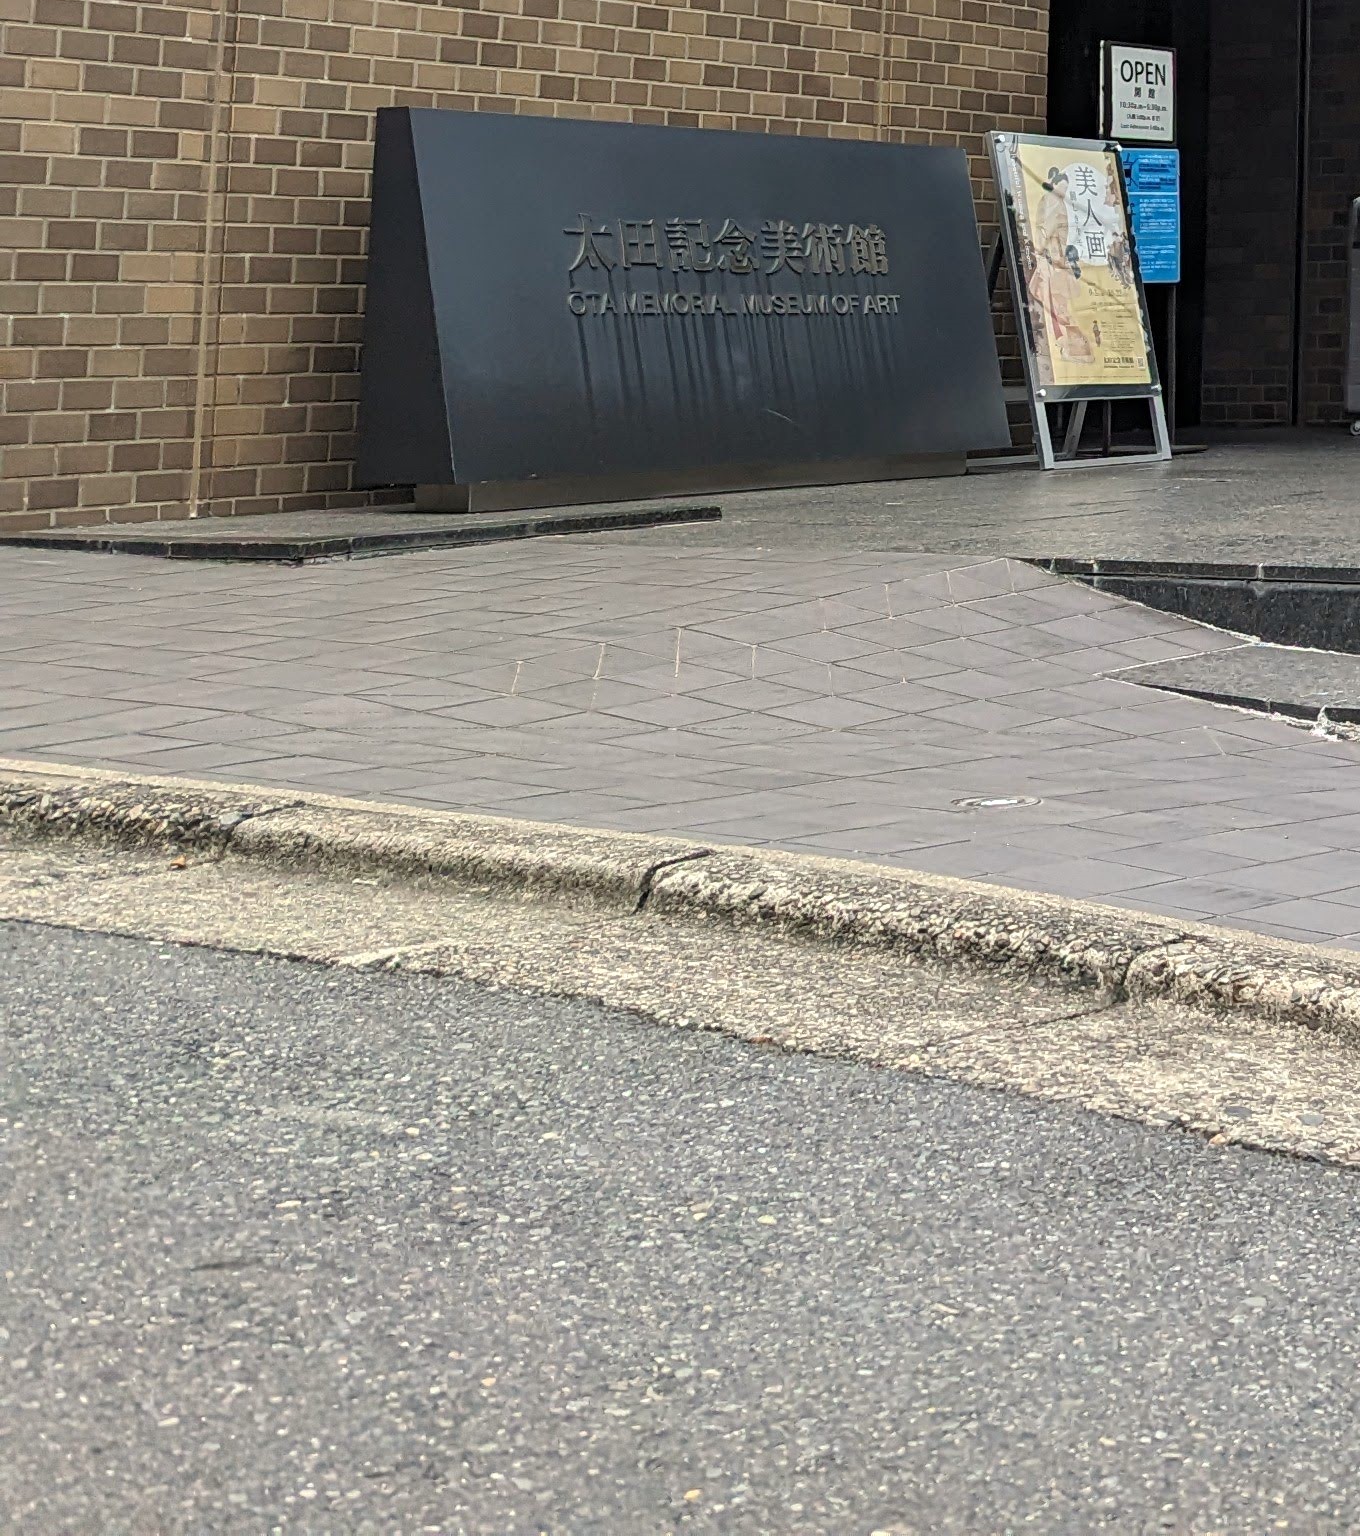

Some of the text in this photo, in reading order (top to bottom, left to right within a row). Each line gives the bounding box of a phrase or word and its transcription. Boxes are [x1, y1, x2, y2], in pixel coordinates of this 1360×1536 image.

[1120, 59, 1166, 86] OPEN
[1074, 166, 1107, 259] 美人画
[562, 213, 889, 275] 太田記念美術館
[622, 293, 738, 315] MEMORIAL
[741, 294, 830, 315] MUSEUM
[832, 294, 859, 315] OF
[863, 293, 900, 314] ART
